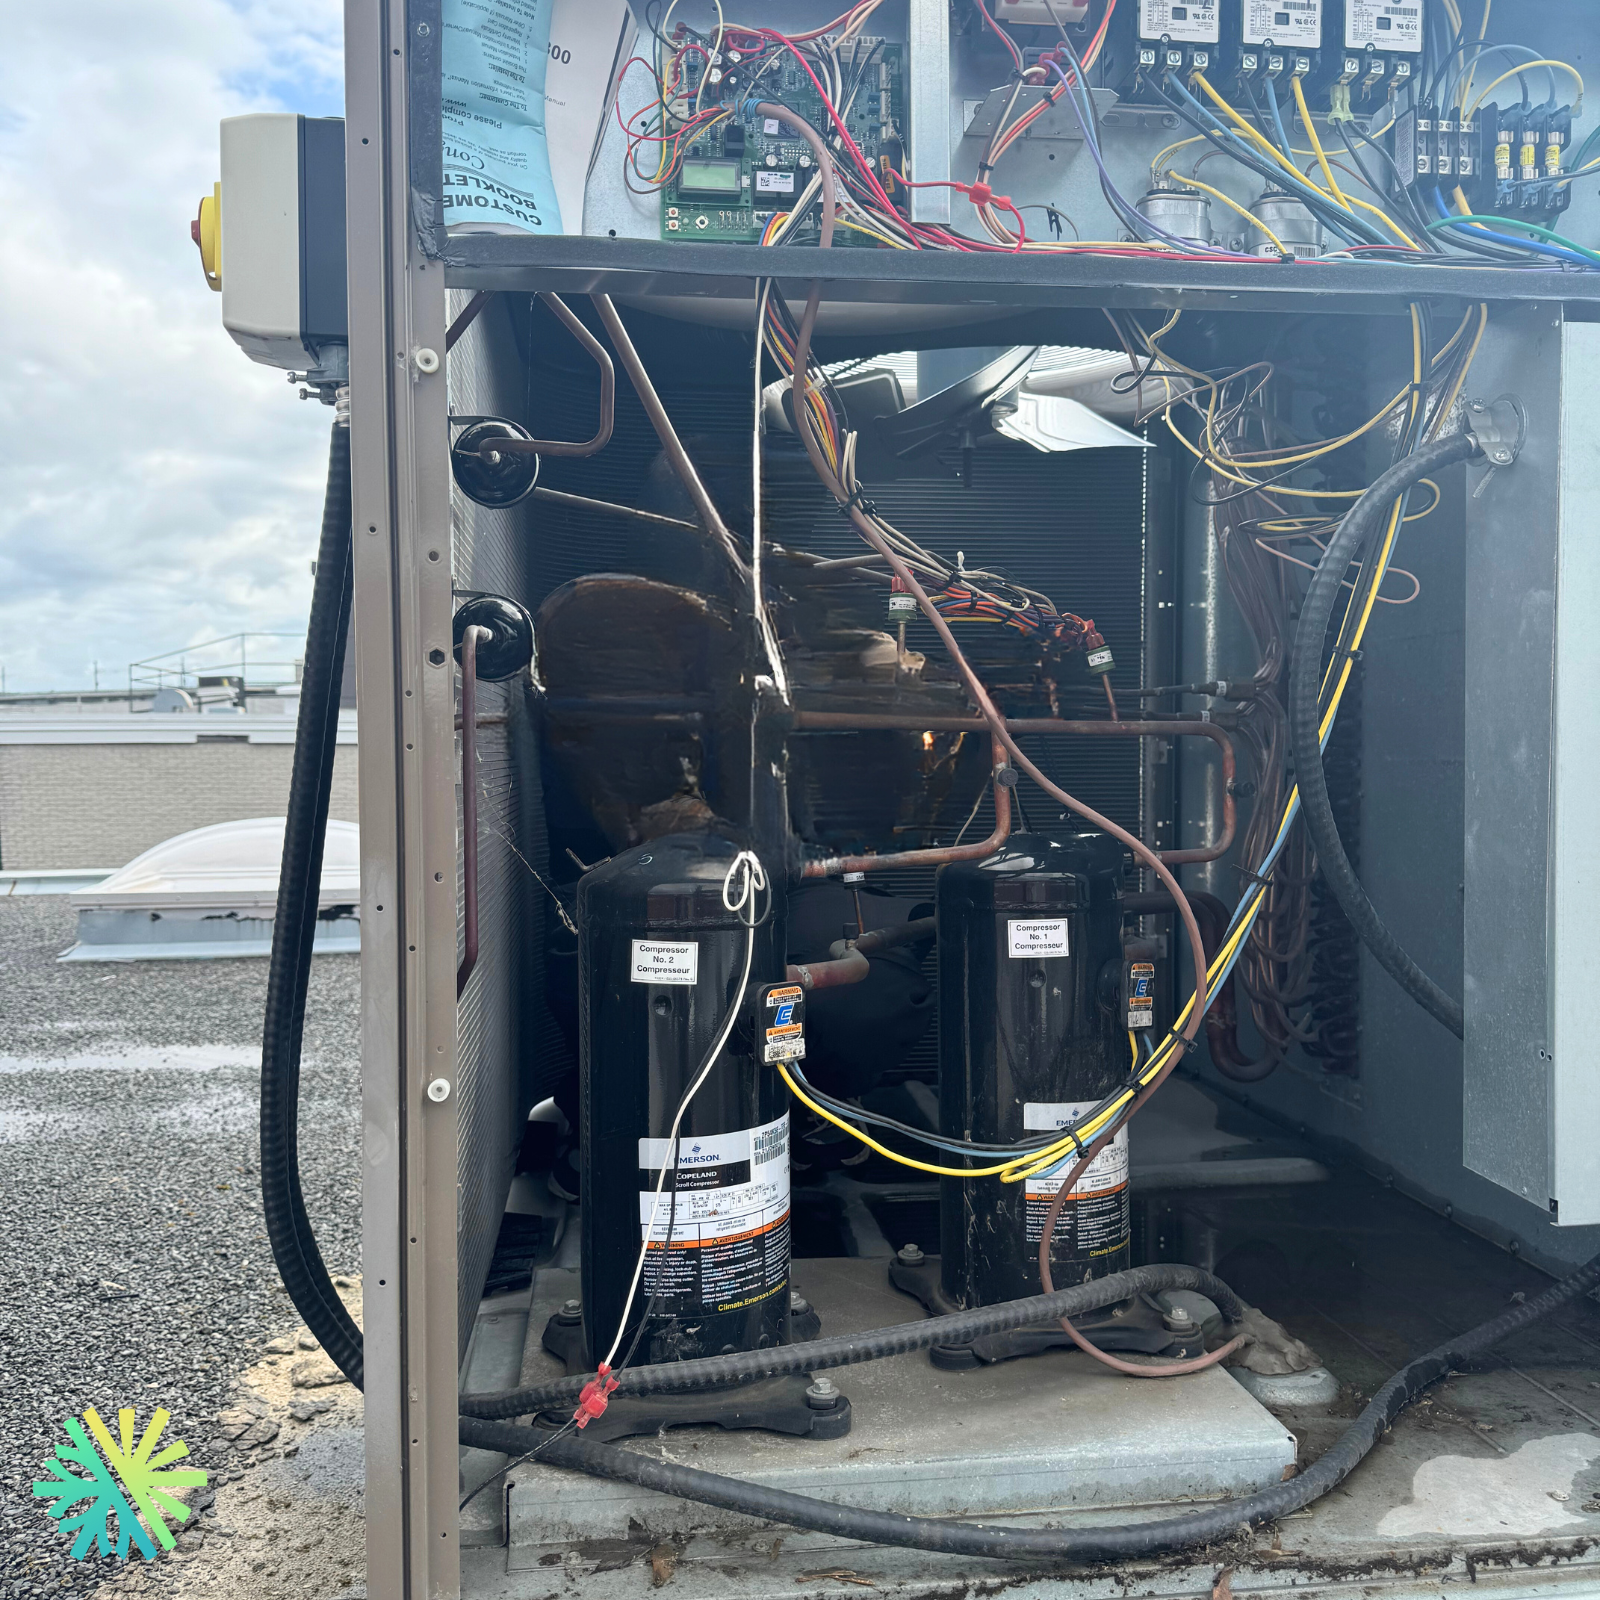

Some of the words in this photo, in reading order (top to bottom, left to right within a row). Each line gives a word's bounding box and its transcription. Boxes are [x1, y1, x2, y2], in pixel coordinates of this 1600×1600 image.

[474, 115, 502, 129] Please
[442, 141, 484, 169] Con
[443, 174, 537, 210] BOOKLET
[443, 195, 542, 226] CUSTOME
[1016, 924, 1060, 932] Compressor
[640, 944, 689, 954] Compressor
[637, 965, 690, 974] Compresseur
[777, 988, 799, 996] WARNING
[679, 1153, 720, 1164] MERSON
[677, 1171, 717, 1180] COPELAND
[719, 1232, 754, 1242] AVERTISSEMENT
